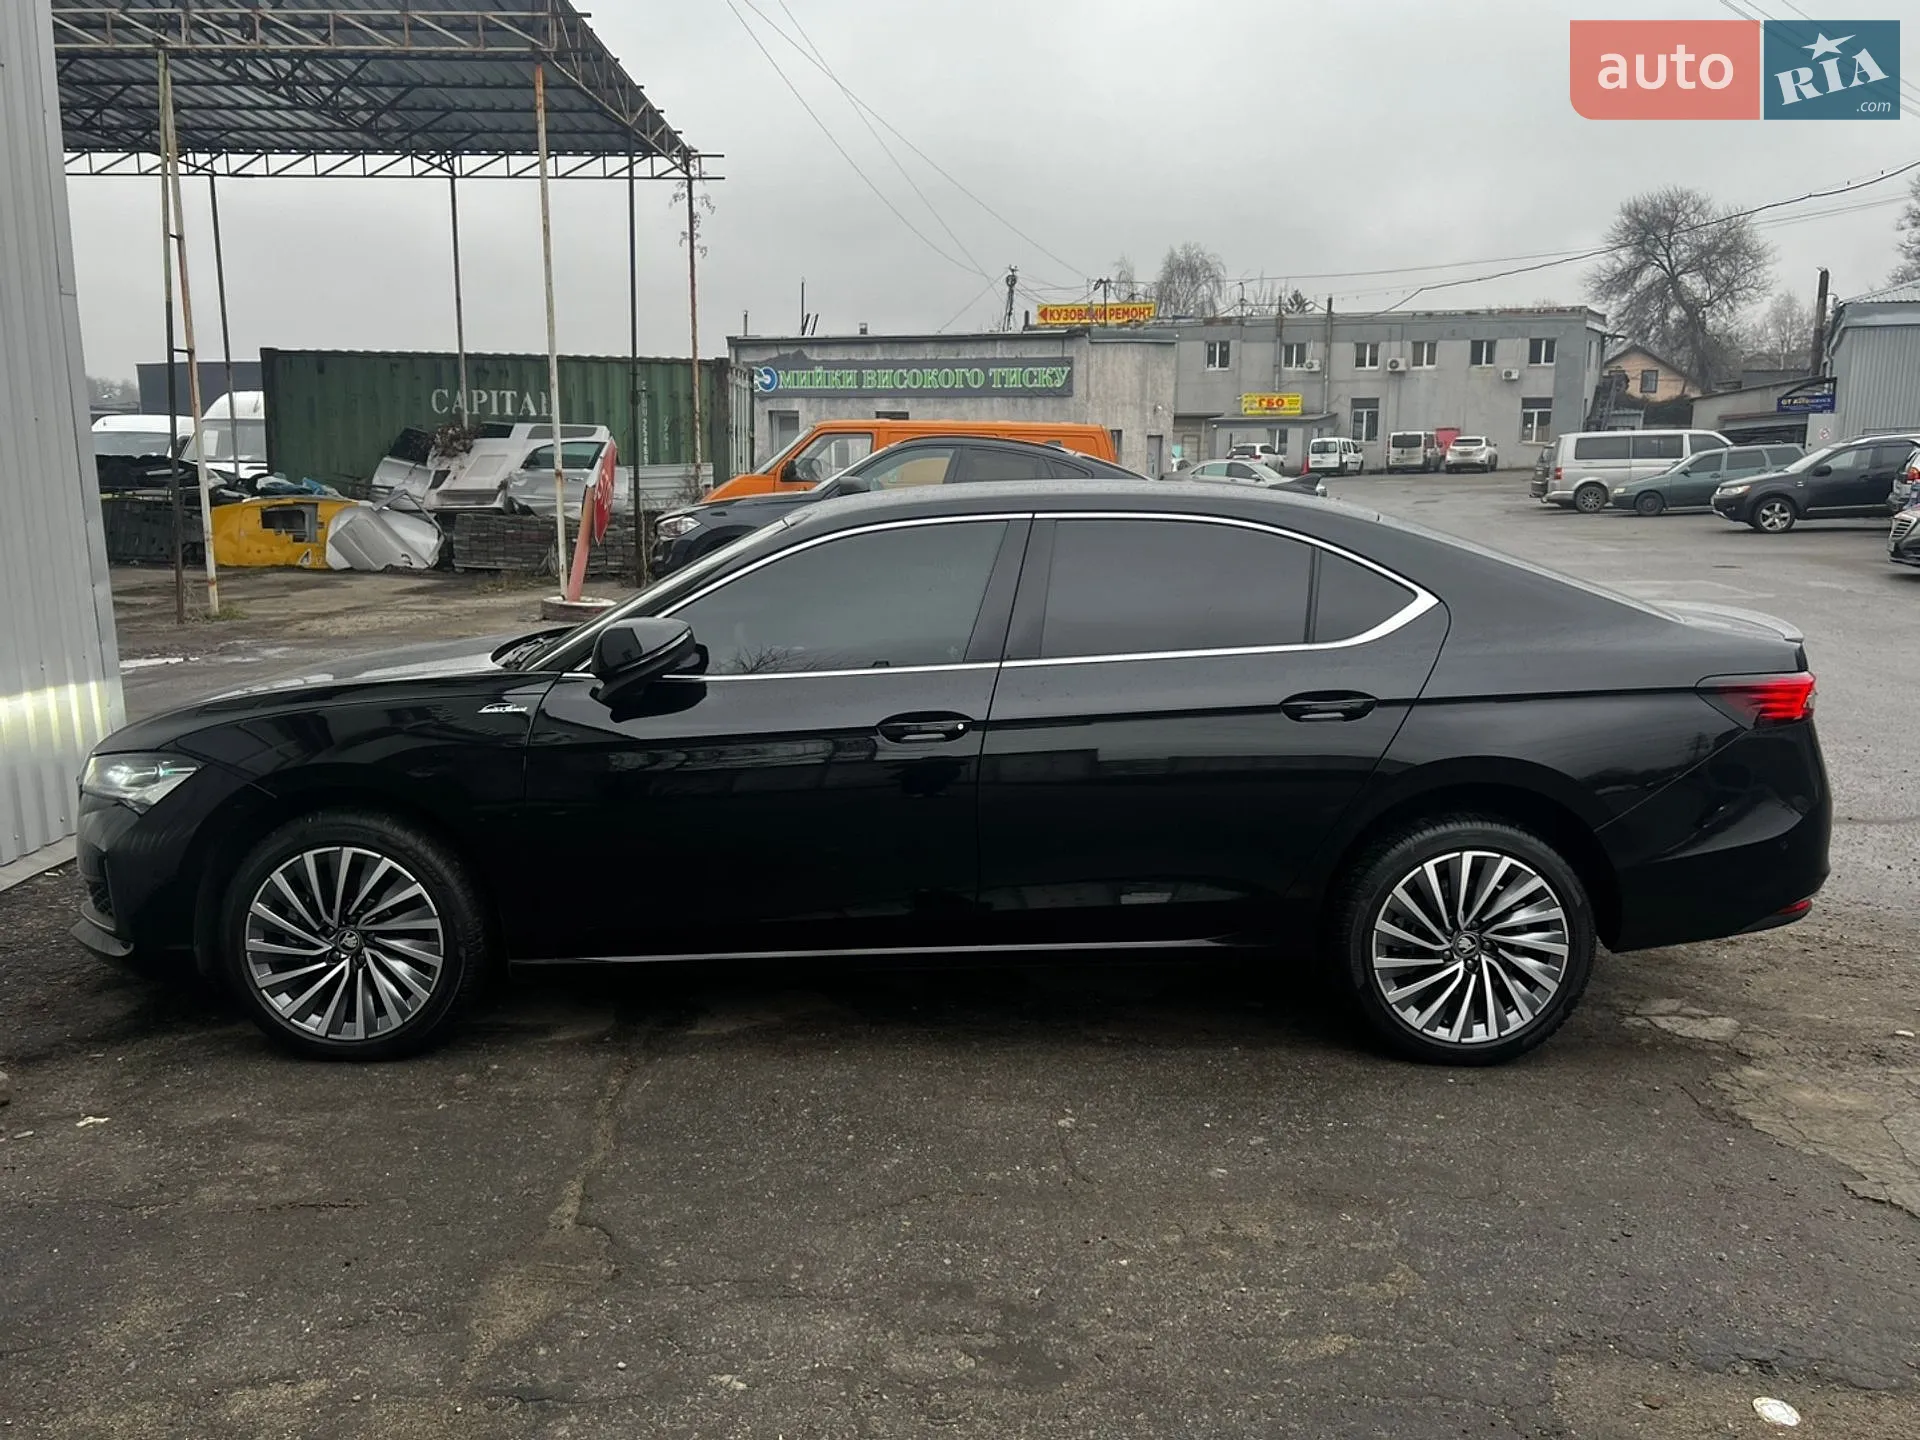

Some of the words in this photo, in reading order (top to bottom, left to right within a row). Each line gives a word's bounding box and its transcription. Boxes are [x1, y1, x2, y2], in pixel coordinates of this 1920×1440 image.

[1109, 306, 1153, 320] РЕМОНТ
[778, 365, 857, 389] МИЙКИ
[862, 367, 985, 389] ВИСОКОГО
[989, 366, 1070, 389] ТИСКУ
[1258, 398, 1285, 408] ГБО
